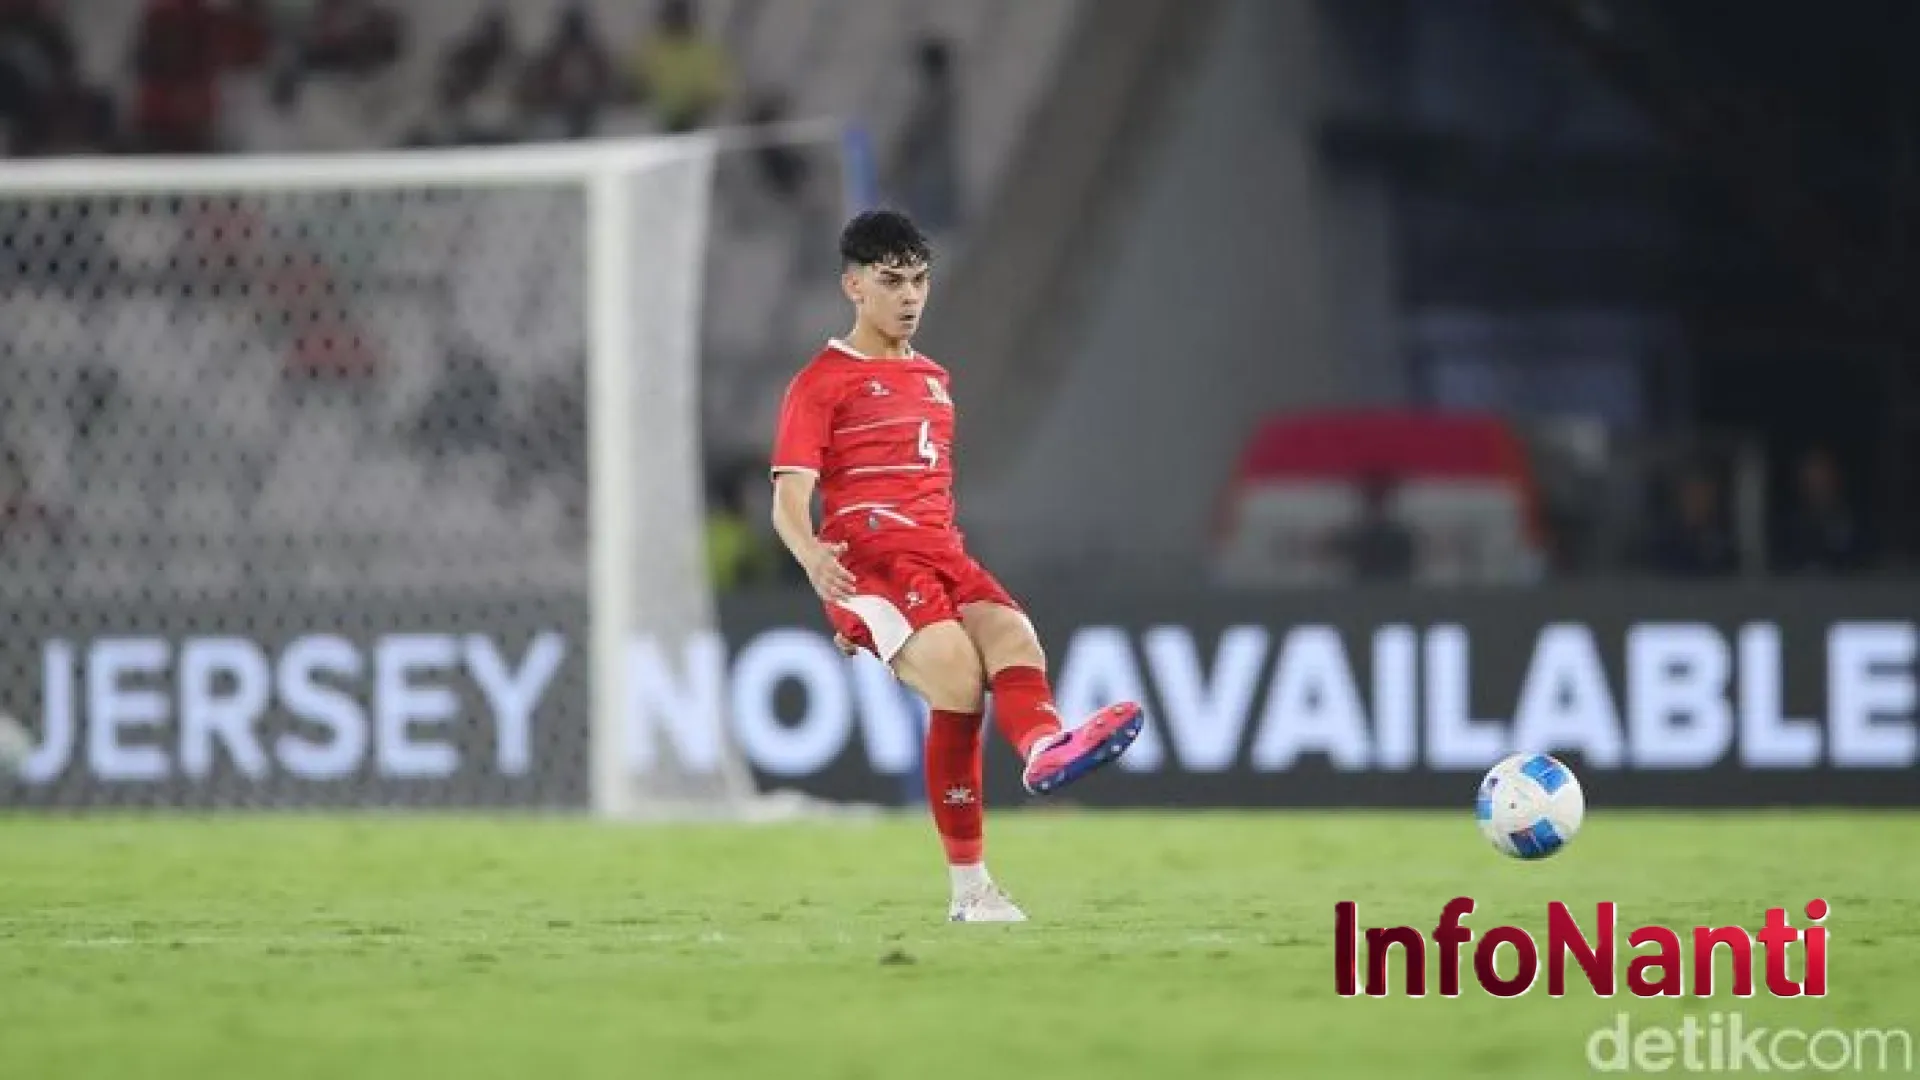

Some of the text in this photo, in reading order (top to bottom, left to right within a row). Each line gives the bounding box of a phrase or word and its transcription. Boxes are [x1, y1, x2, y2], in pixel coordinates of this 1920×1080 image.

[917, 419, 938, 469] 4
[18, 632, 566, 784] JERSEY
[1052, 621, 1920, 772] AVAILABLE
